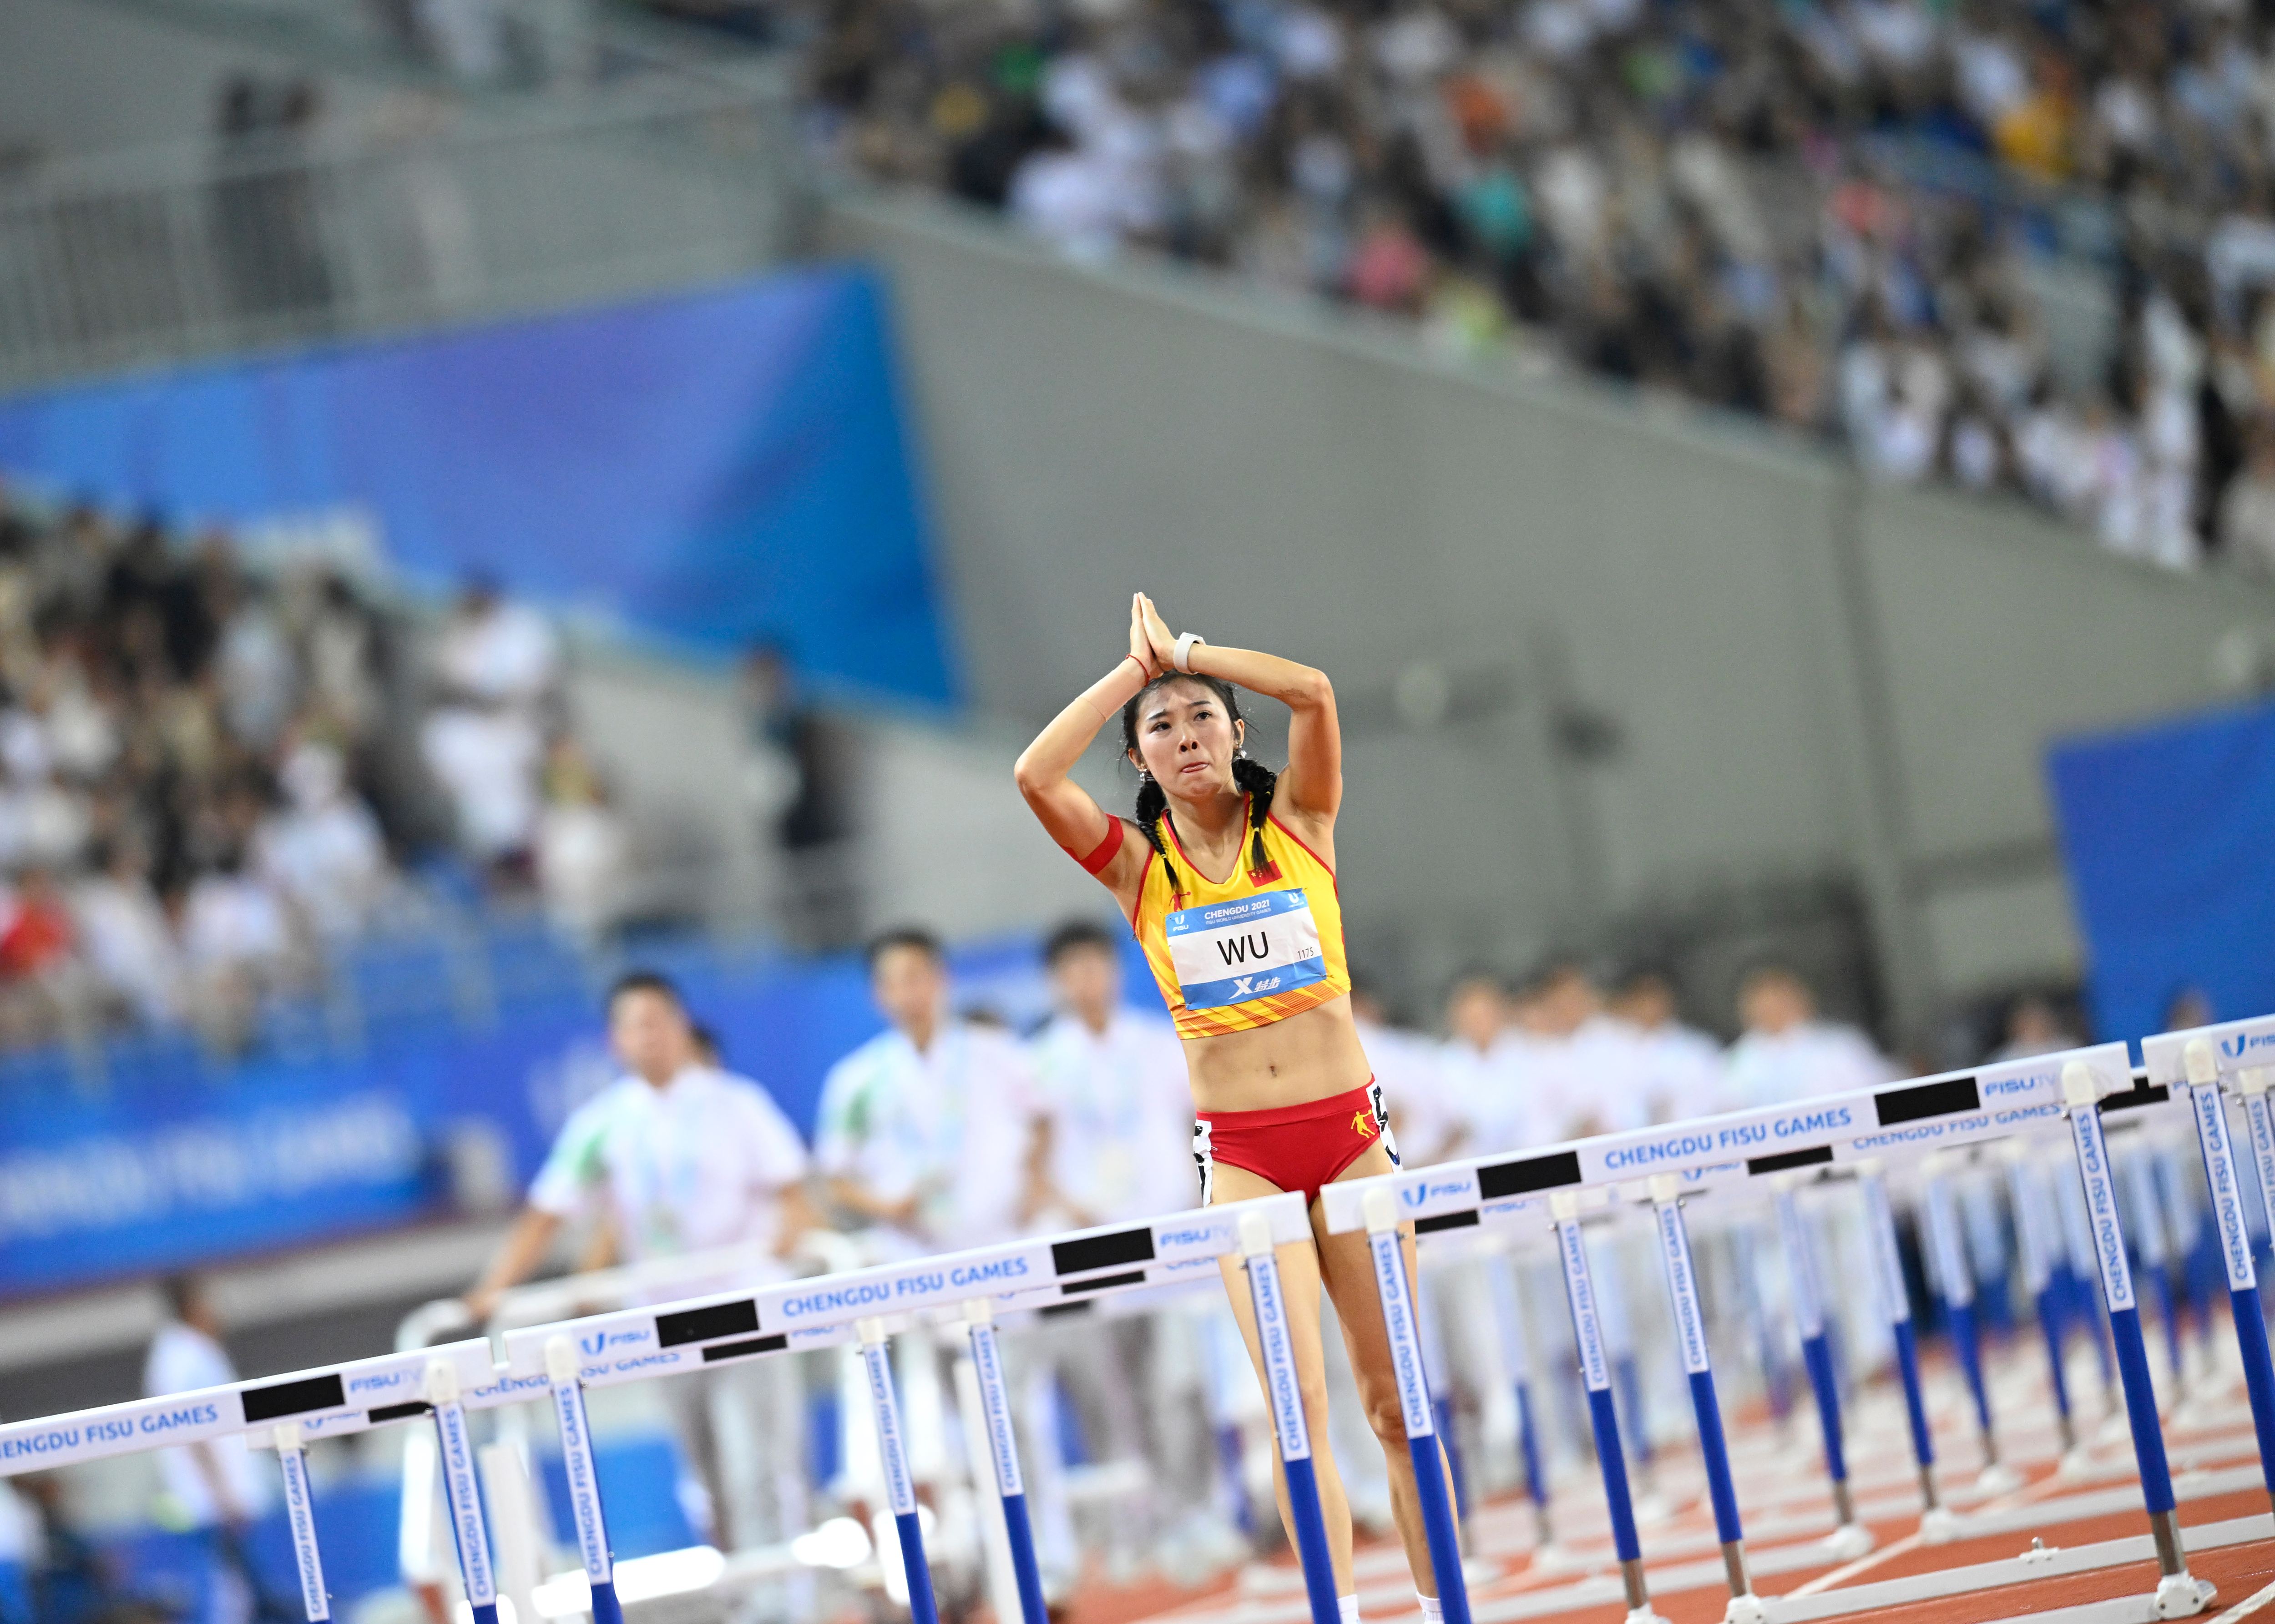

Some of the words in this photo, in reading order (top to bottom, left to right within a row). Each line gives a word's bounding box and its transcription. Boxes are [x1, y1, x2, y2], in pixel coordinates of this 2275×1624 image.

[1204, 904, 1249, 920] CHENGDU
[1251, 899, 1269, 910] 2021
[1232, 912, 1255, 920] UNIVERSITY
[1216, 932, 1269, 965] WU
[1297, 948, 1314, 959] 1175
[1253, 977, 1280, 993] 特步
[1605, 1134, 1712, 1170] CHENGDU
[1719, 1123, 1767, 1148] FISU
[1773, 1108, 1852, 1138] GAMES
[1853, 1124, 1944, 1150] CHENGDU
[1949, 1114, 1989, 1134] FISU
[1995, 1103, 2061, 1124] GAMES
[2077, 1113, 2101, 1173] GAMES
[2200, 1092, 2223, 1152] GAMES
[1431, 1181, 1471, 1197] FISU
[2090, 1177, 2108, 1215] FISU
[2214, 1155, 2232, 1194] FISU
[2098, 1218, 2127, 1301] CHENGDU
[2222, 1197, 2248, 1281] CHENGDU
[783, 1281, 890, 1317] CHENGDU
[896, 1272, 945, 1297] FISU
[950, 1256, 1029, 1287] GAMES
[1256, 1262, 1278, 1323] GAMES
[1378, 1240, 1399, 1301] GAMES
[1268, 1326, 1284, 1364] FISU
[1390, 1304, 1407, 1342] FISU
[1275, 1367, 1301, 1451] CHENGDU
[1398, 1345, 1424, 1428] CHENGDU
[0, 1427, 79, 1458] ENGDU
[86, 1418, 134, 1444] FISU
[140, 1403, 218, 1434] GAMES
